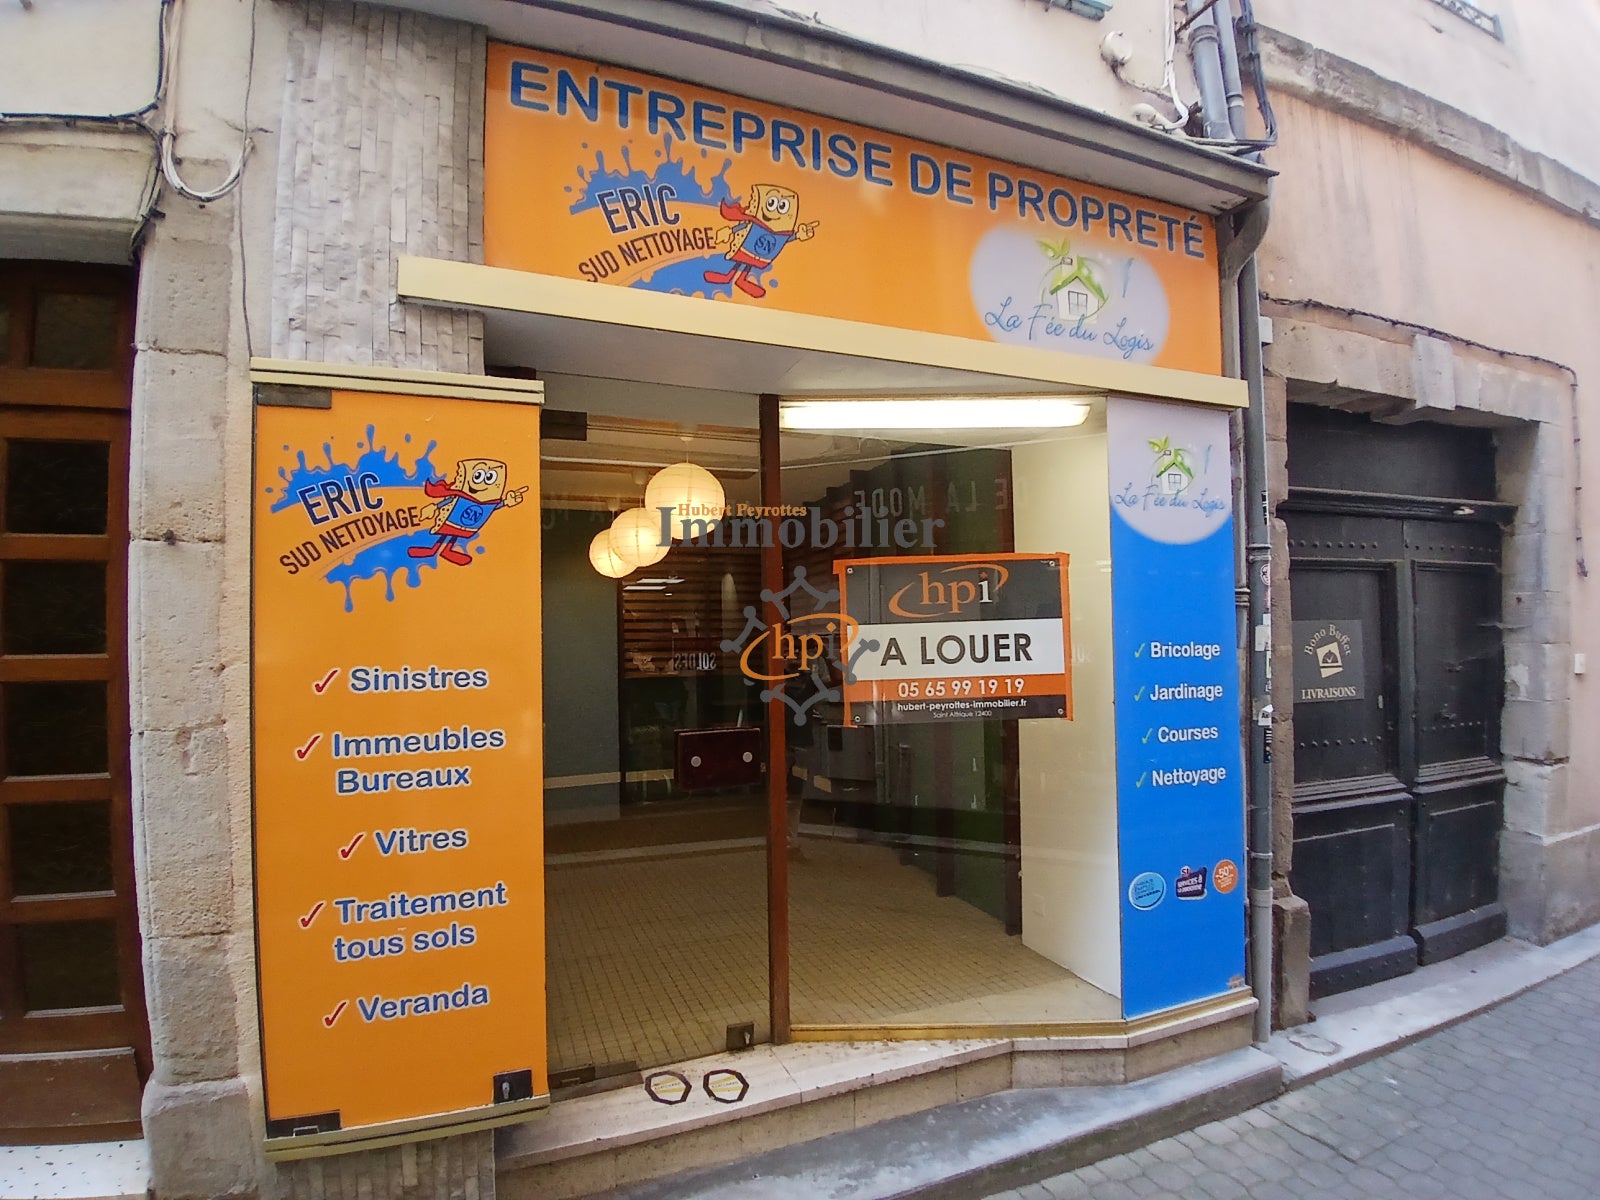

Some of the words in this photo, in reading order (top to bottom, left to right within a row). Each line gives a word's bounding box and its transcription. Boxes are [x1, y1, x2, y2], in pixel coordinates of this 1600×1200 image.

[510, 60, 893, 186] ENTREPRISE
[910, 153, 973, 205] DE
[988, 172, 1205, 259] PROPRETÉ
[597, 183, 680, 235] ERIC
[579, 250, 619, 282] SUD
[618, 227, 717, 266] NETTOYAGE
[984, 296, 1022, 333] La
[1027, 303, 1065, 340] Fée
[1069, 313, 1098, 341] du
[1103, 317, 1154, 359] Logis
[298, 472, 385, 527] ERIC
[1115, 482, 1137, 508] La
[1169, 489, 1189, 508] du
[1193, 488, 1225, 518] Logis
[279, 540, 322, 575] SUD
[319, 506, 421, 553] NETTOYAGE
[918, 571, 993, 613] hpi
[880, 637, 907, 666] A
[920, 633, 1033, 665] LOUER
[1150, 642, 1220, 660] Bricolage
[1303, 628, 1326, 655] Bono
[350, 667, 488, 692] Sinistres
[898, 682, 919, 698] 05
[925, 681, 946, 697] 65
[951, 680, 972, 696] 99
[978, 679, 998, 695] 19
[1005, 678, 1025, 694] 19
[1150, 683, 1223, 701] Jardinage
[1301, 686, 1356, 699] LIVRAISONS
[897, 699, 1028, 711] hubert-peyrottes-immobilier.fr
[975, 709, 993, 717] 12400
[333, 727, 505, 757] Immeubles
[1157, 726, 1218, 743] Courses
[337, 767, 470, 794] Bureaux
[1152, 766, 1226, 786] Nettoyage
[375, 829, 467, 855] Vitres
[334, 882, 507, 923] Traitement
[334, 936, 404, 961] tous
[413, 923, 475, 951] sols
[358, 984, 488, 1021] Veranda
